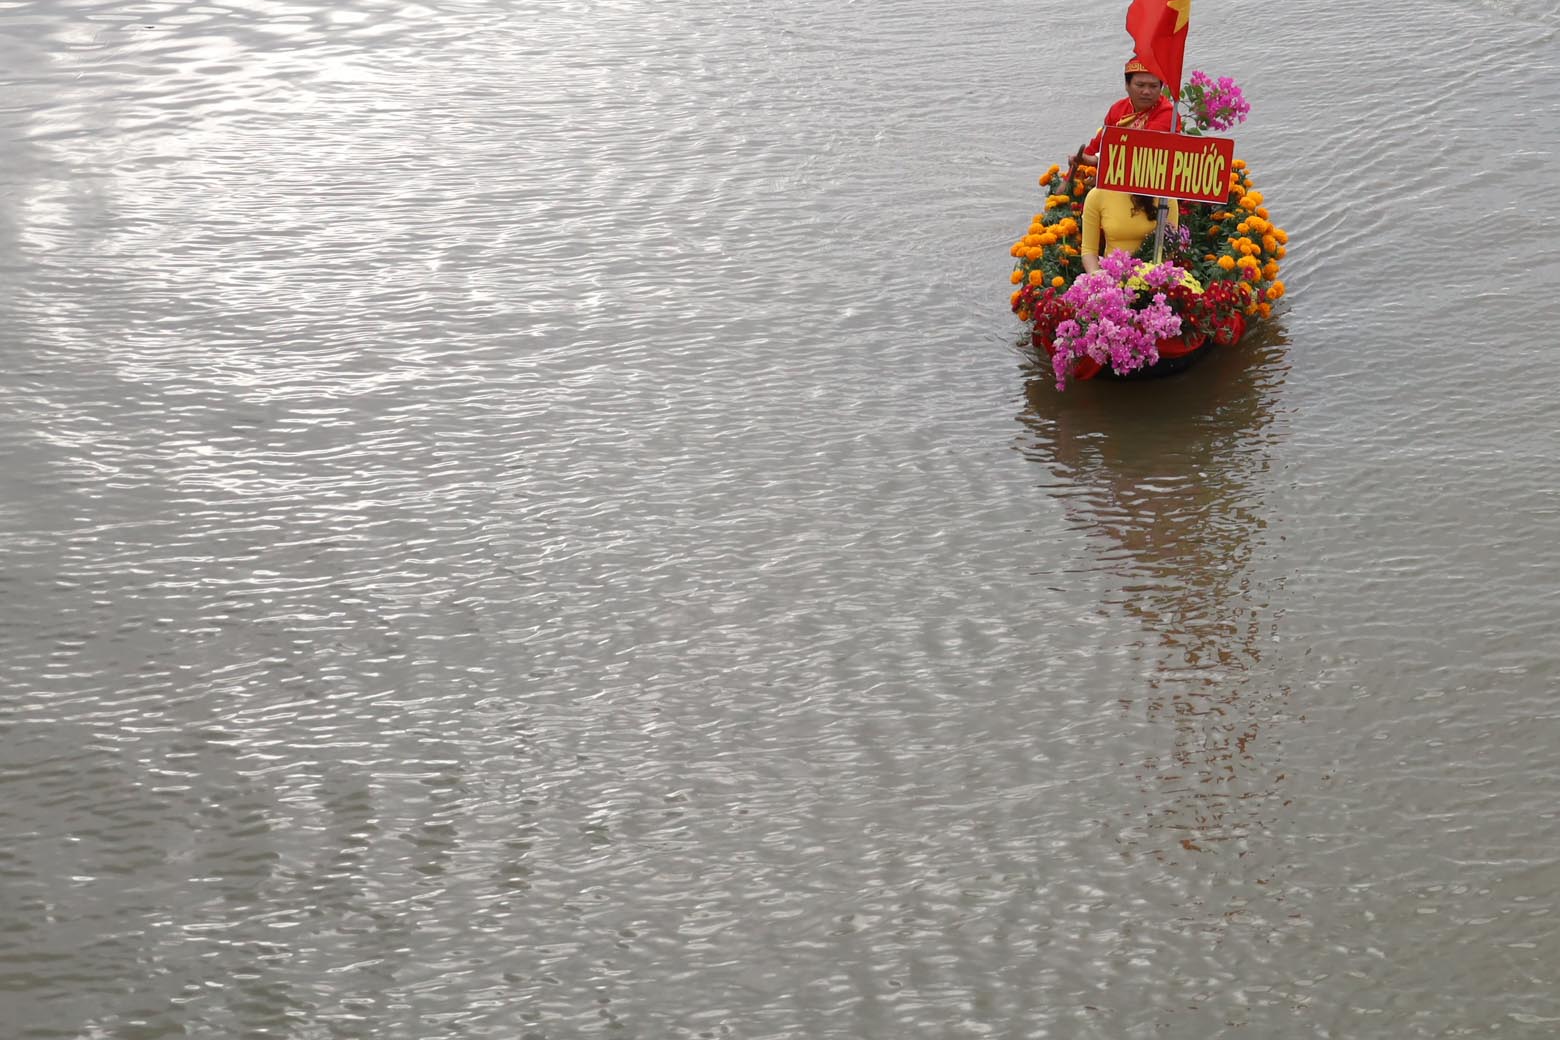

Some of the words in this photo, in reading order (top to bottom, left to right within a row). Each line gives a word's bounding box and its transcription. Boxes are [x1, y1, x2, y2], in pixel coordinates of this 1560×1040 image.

[1104, 134, 1128, 185] XÃ
[1130, 146, 1169, 190] NINH
[1170, 143, 1225, 197] PHƯỚC
